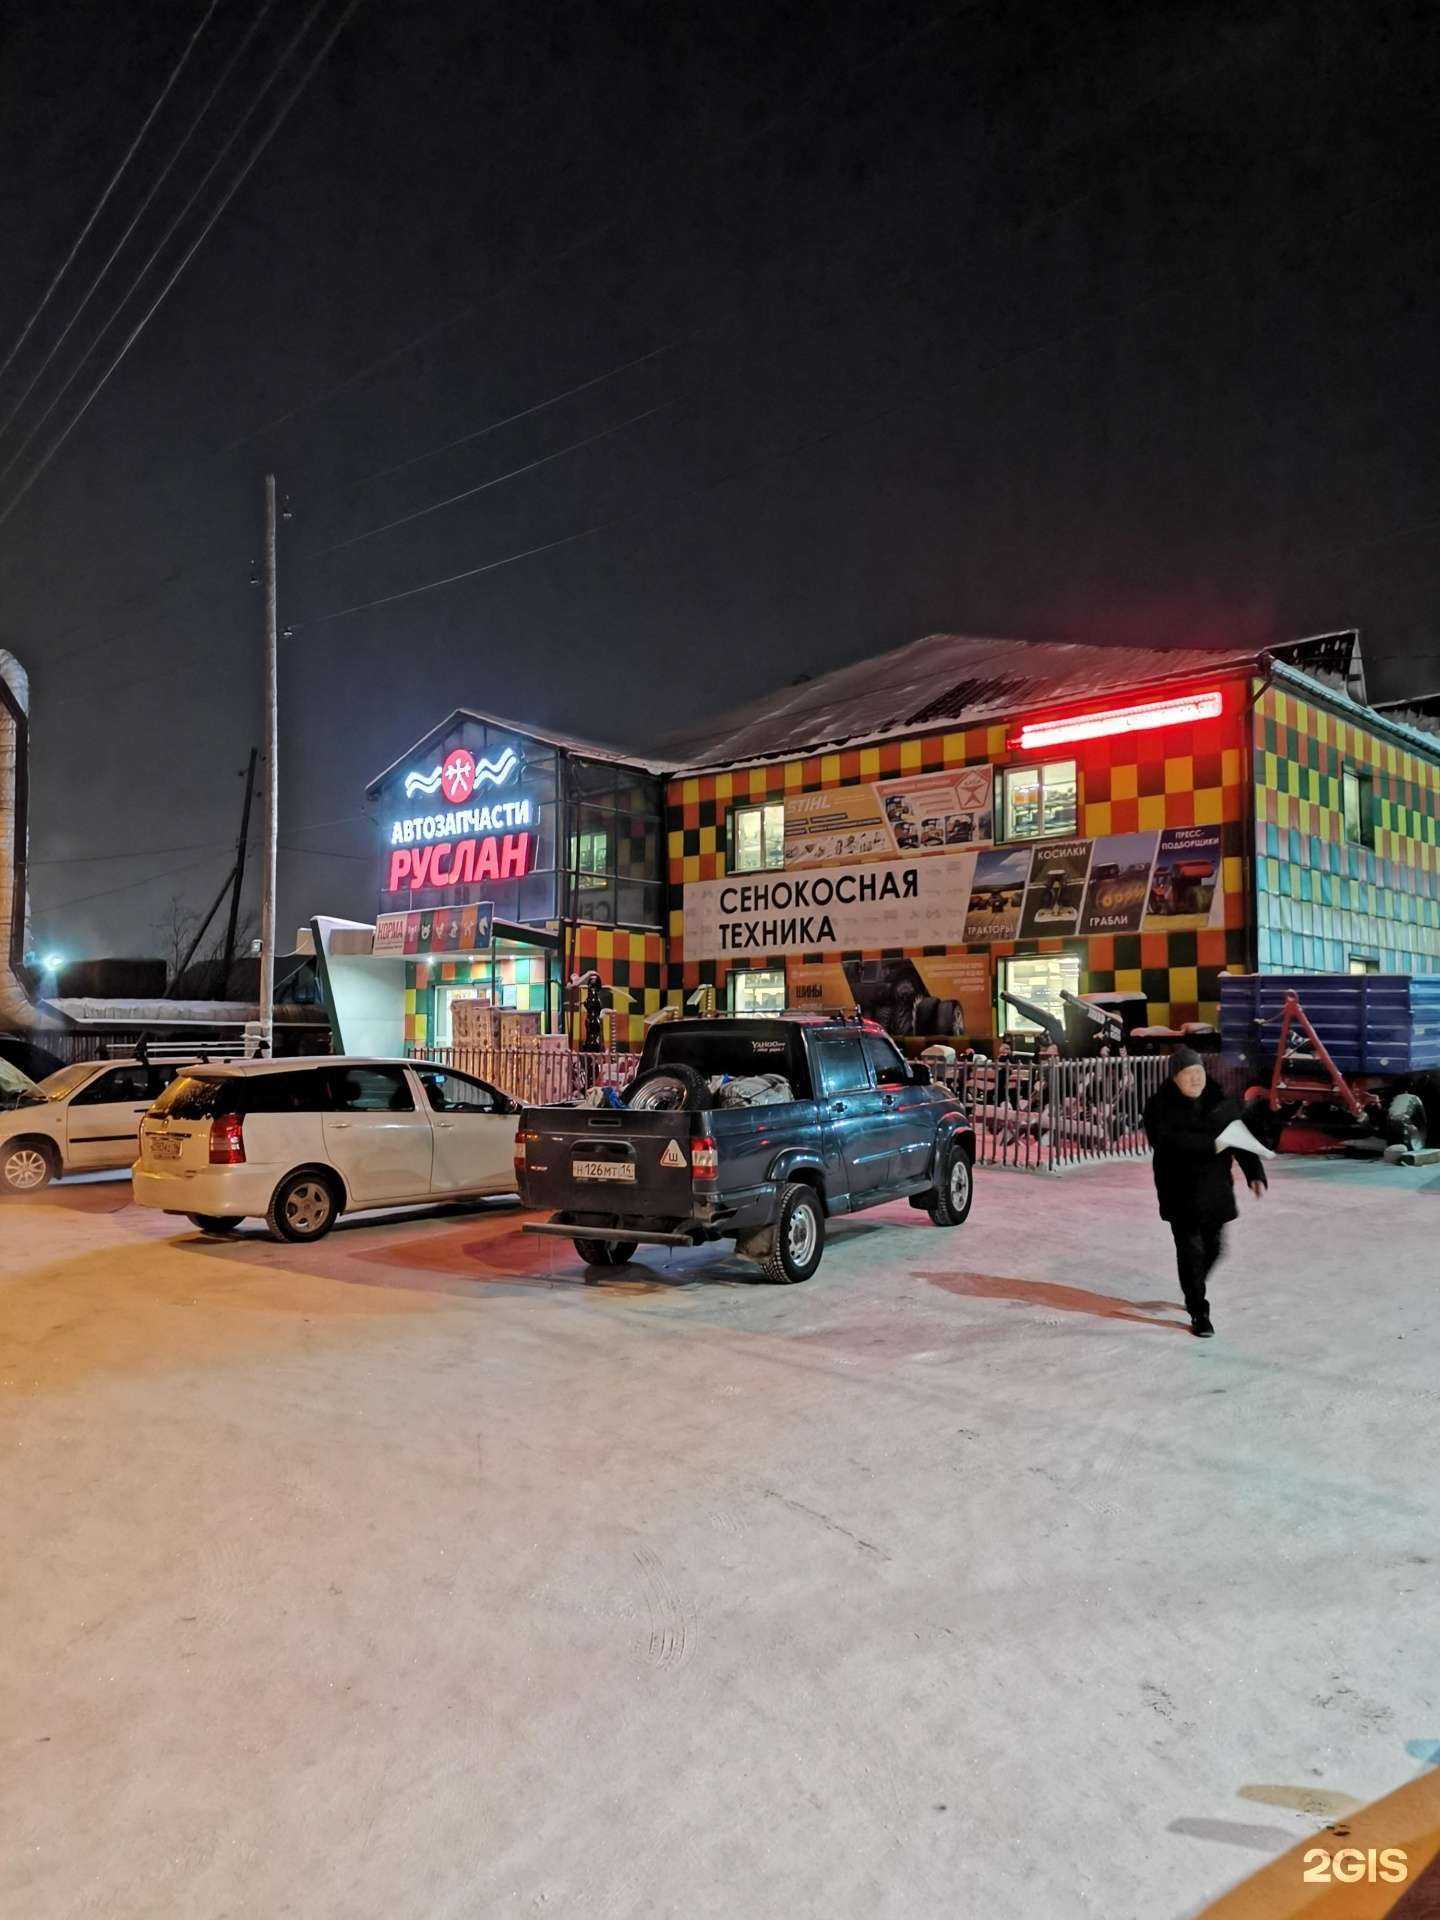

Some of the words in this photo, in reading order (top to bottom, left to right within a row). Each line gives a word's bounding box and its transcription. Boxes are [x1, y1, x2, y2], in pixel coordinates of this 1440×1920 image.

[787, 795, 832, 815] STIHL
[391, 799, 531, 845] АВТОЗАПЧАСТИ
[1174, 829, 1206, 840] ПРЕСС-
[1161, 838, 1220, 851] ПОДБОРЩИКИ
[1037, 847, 1088, 861] КОСИЛКИ
[389, 832, 530, 891] РУСЛАН
[720, 869, 918, 915] СЕНОКОСНАЯ
[1089, 915, 1129, 927] ГРАБЛИ
[719, 915, 836, 950] ТЕХНИКА
[967, 924, 1016, 936] ТРАКТОРЫ
[795, 984, 823, 998] ШИНЫ
[668, 1152, 678, 1162] Ш
